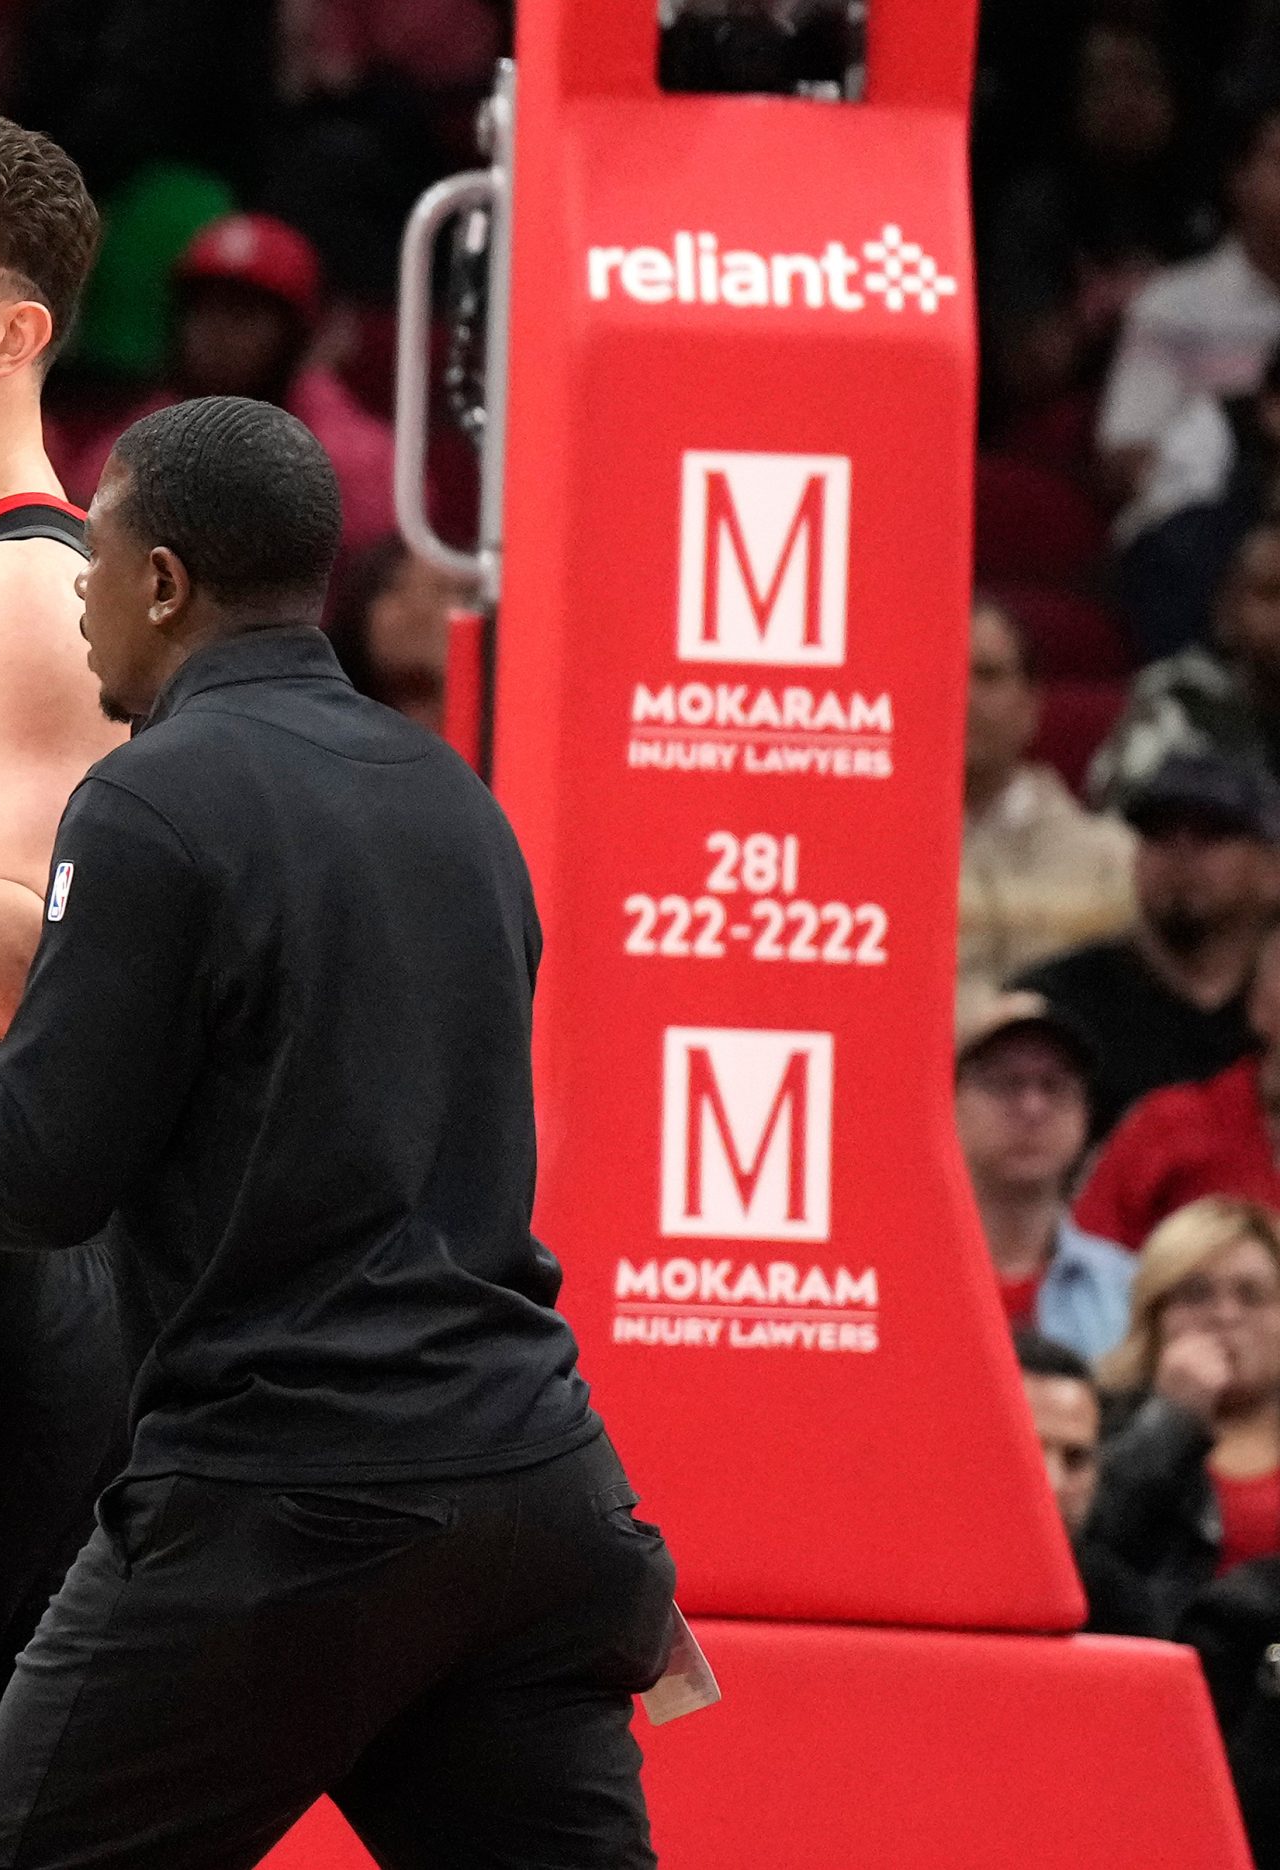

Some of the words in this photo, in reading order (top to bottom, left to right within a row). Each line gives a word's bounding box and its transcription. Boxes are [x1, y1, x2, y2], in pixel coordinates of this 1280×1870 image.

[587, 231, 865, 311] reliant
[701, 469, 827, 648] M
[632, 682, 893, 732] MOKARAM
[628, 740, 738, 771] INJURY
[743, 745, 893, 778] LAWYERS
[705, 831, 799, 895] 281
[624, 893, 888, 965] 222-2222
[683, 1045, 811, 1223] M
[615, 1257, 879, 1306] MOKARAM
[613, 1314, 723, 1346] INJURY
[728, 1318, 878, 1353] LAWYERS
